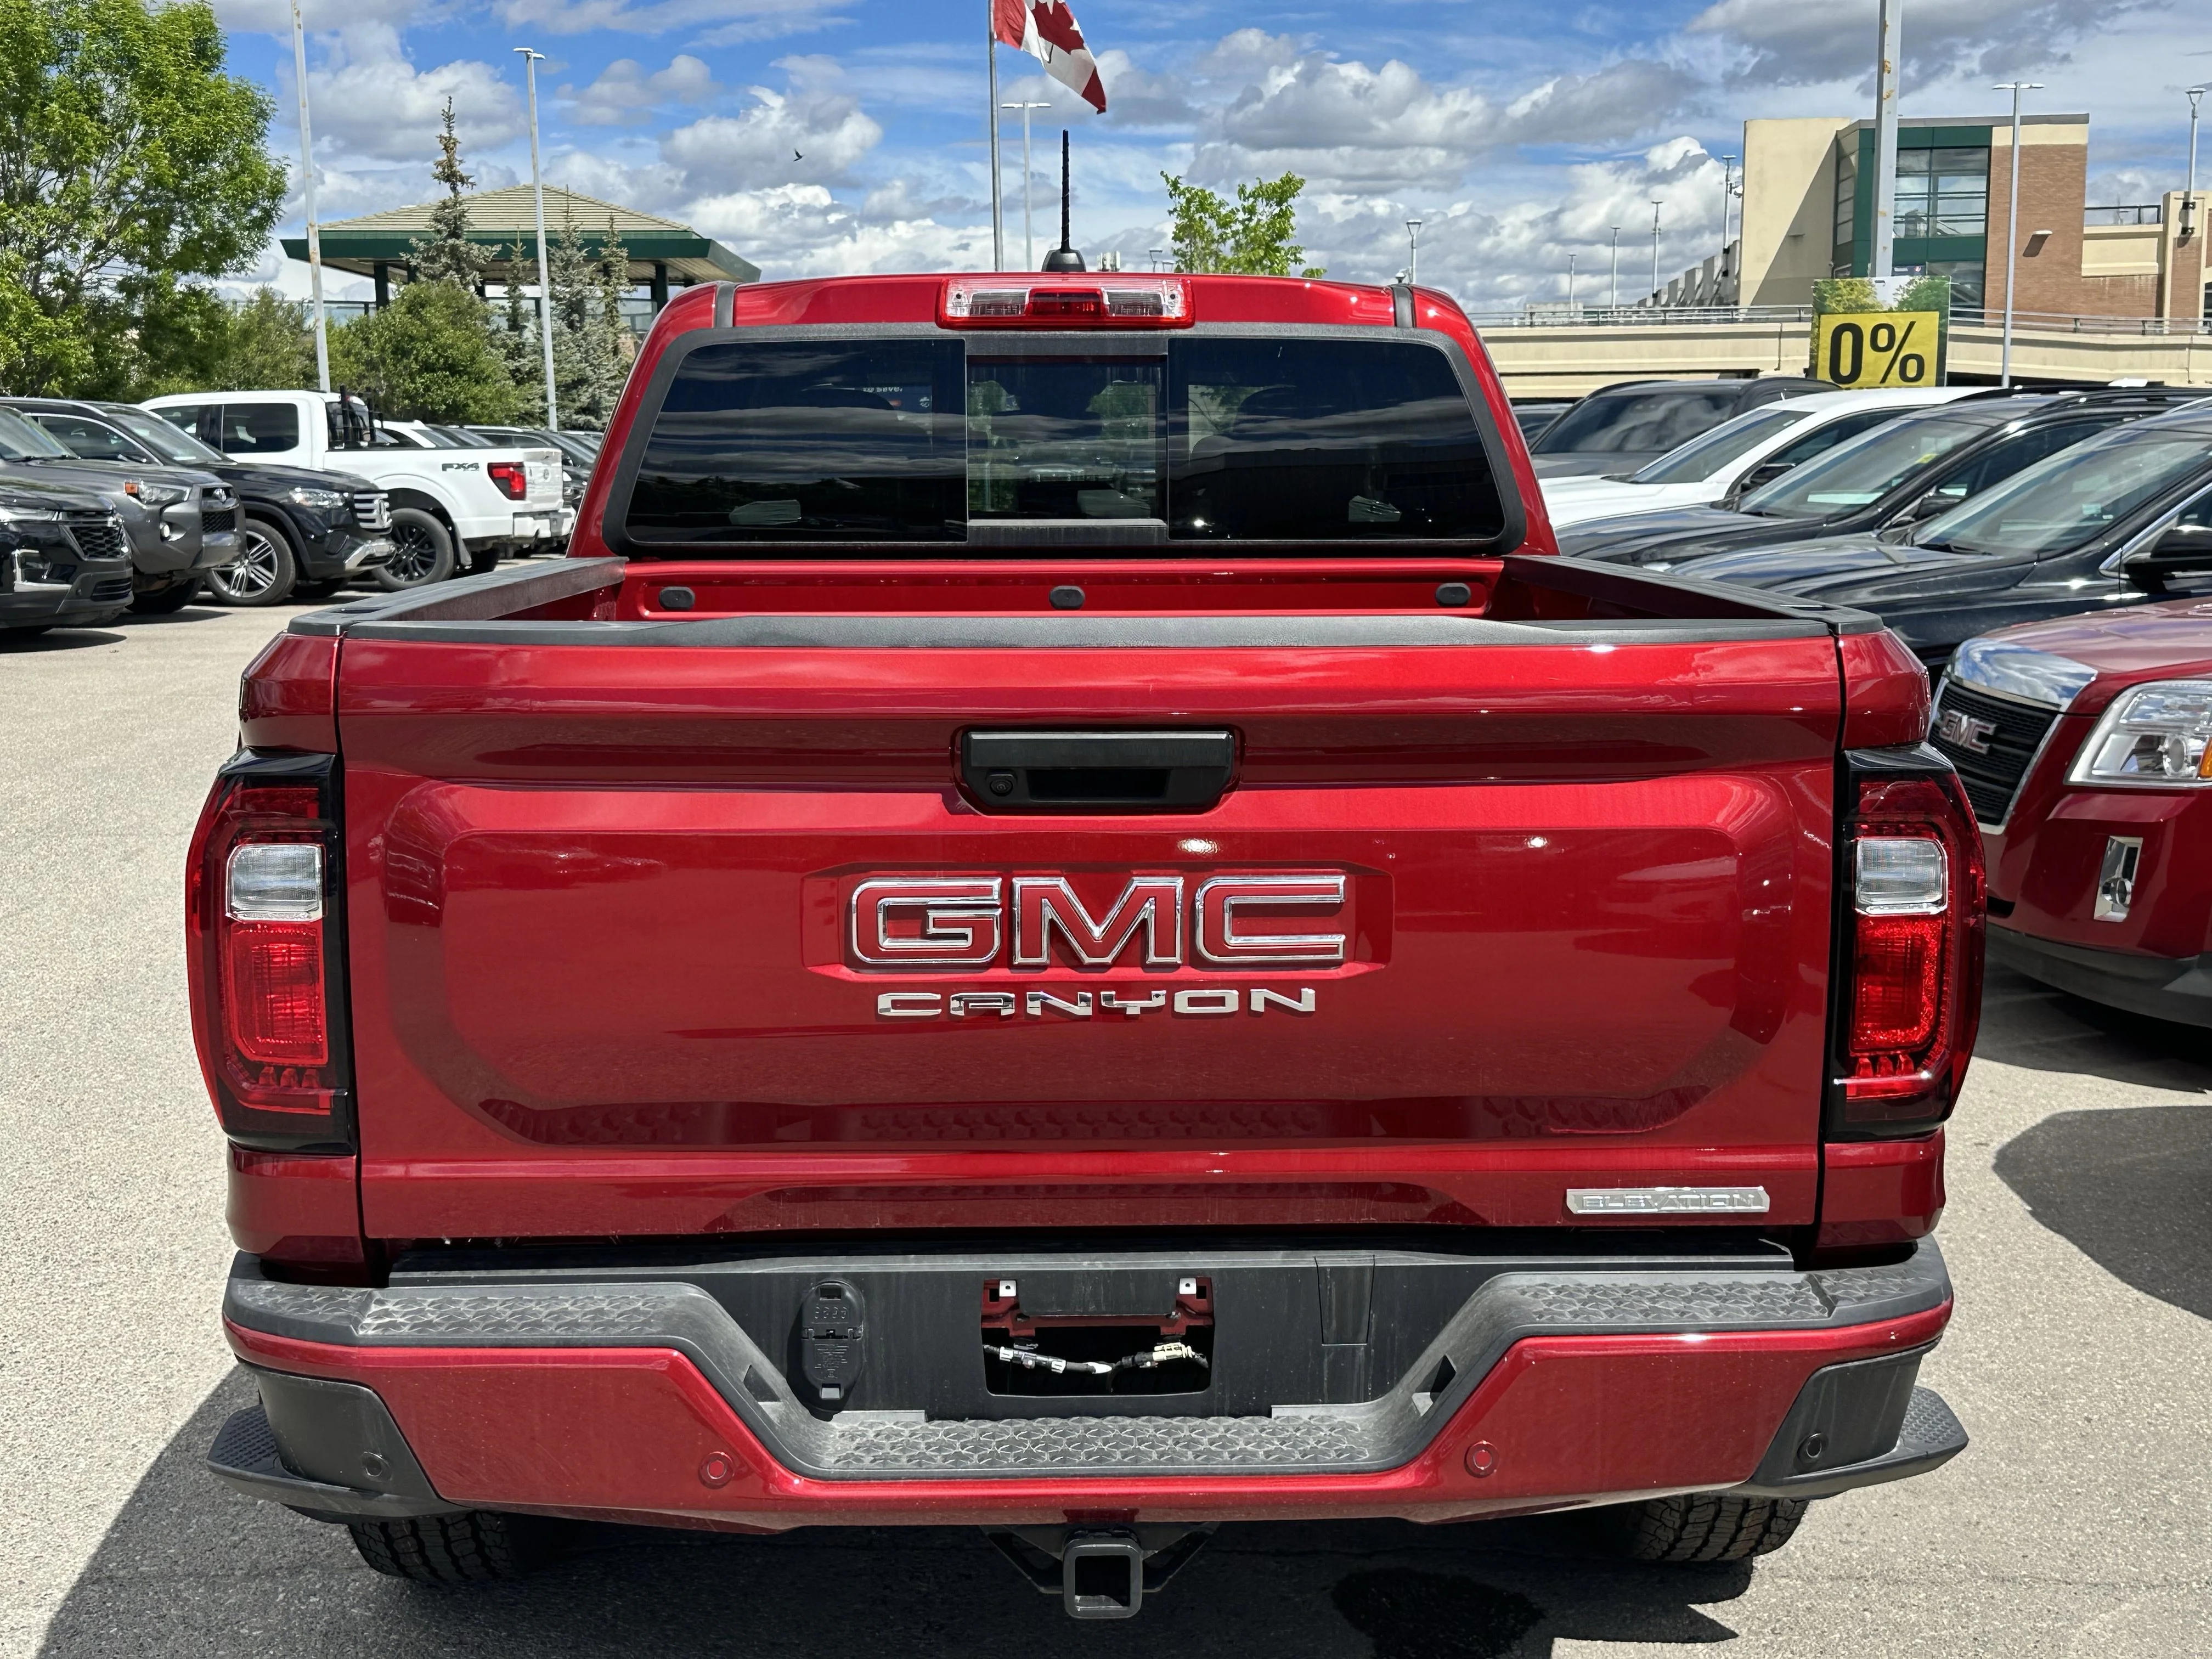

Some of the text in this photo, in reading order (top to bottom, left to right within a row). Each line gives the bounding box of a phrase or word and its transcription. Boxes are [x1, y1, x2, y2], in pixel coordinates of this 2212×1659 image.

[1829, 321, 1925, 385] 0%
[442, 462, 479, 471] FX4
[1939, 710, 1997, 754] GMC
[851, 876, 1346, 966] GMC
[878, 988, 1317, 1017] CANYON
[1582, 1194, 1756, 1209] ELEVATION
